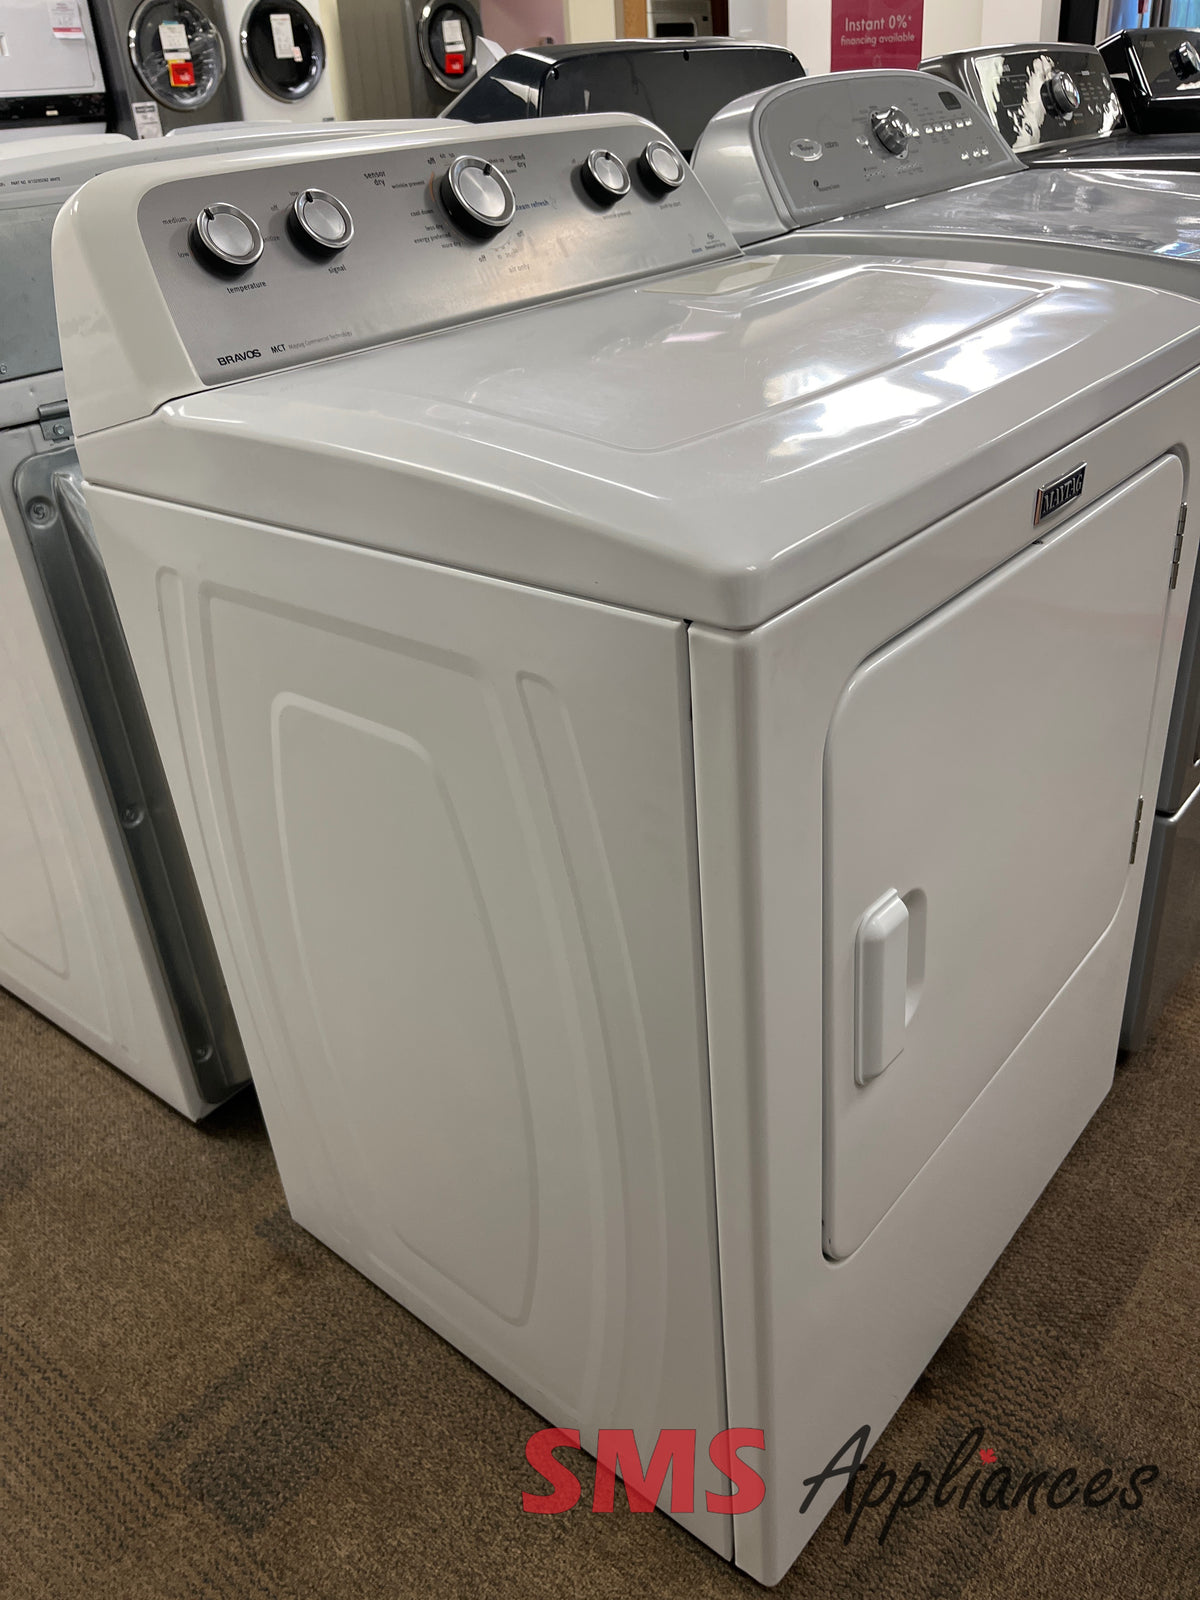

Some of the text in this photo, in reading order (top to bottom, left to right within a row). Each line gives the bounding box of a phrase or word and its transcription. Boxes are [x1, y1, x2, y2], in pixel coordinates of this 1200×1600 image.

[845, 17, 885, 31] Instant
[840, 32, 915, 47] financing available
[427, 157, 436, 165] off
[509, 153, 526, 161] timed
[363, 171, 386, 179] sensor
[373, 179, 386, 187] dry
[515, 200, 549, 212] team refresh
[162, 216, 187, 225] medium
[328, 264, 347, 275] signal
[226, 281, 267, 295] temperature
[216, 348, 262, 367] BRAVOS
[270, 343, 286, 355] MCT
[1042, 473, 1083, 514] MAYTAG
